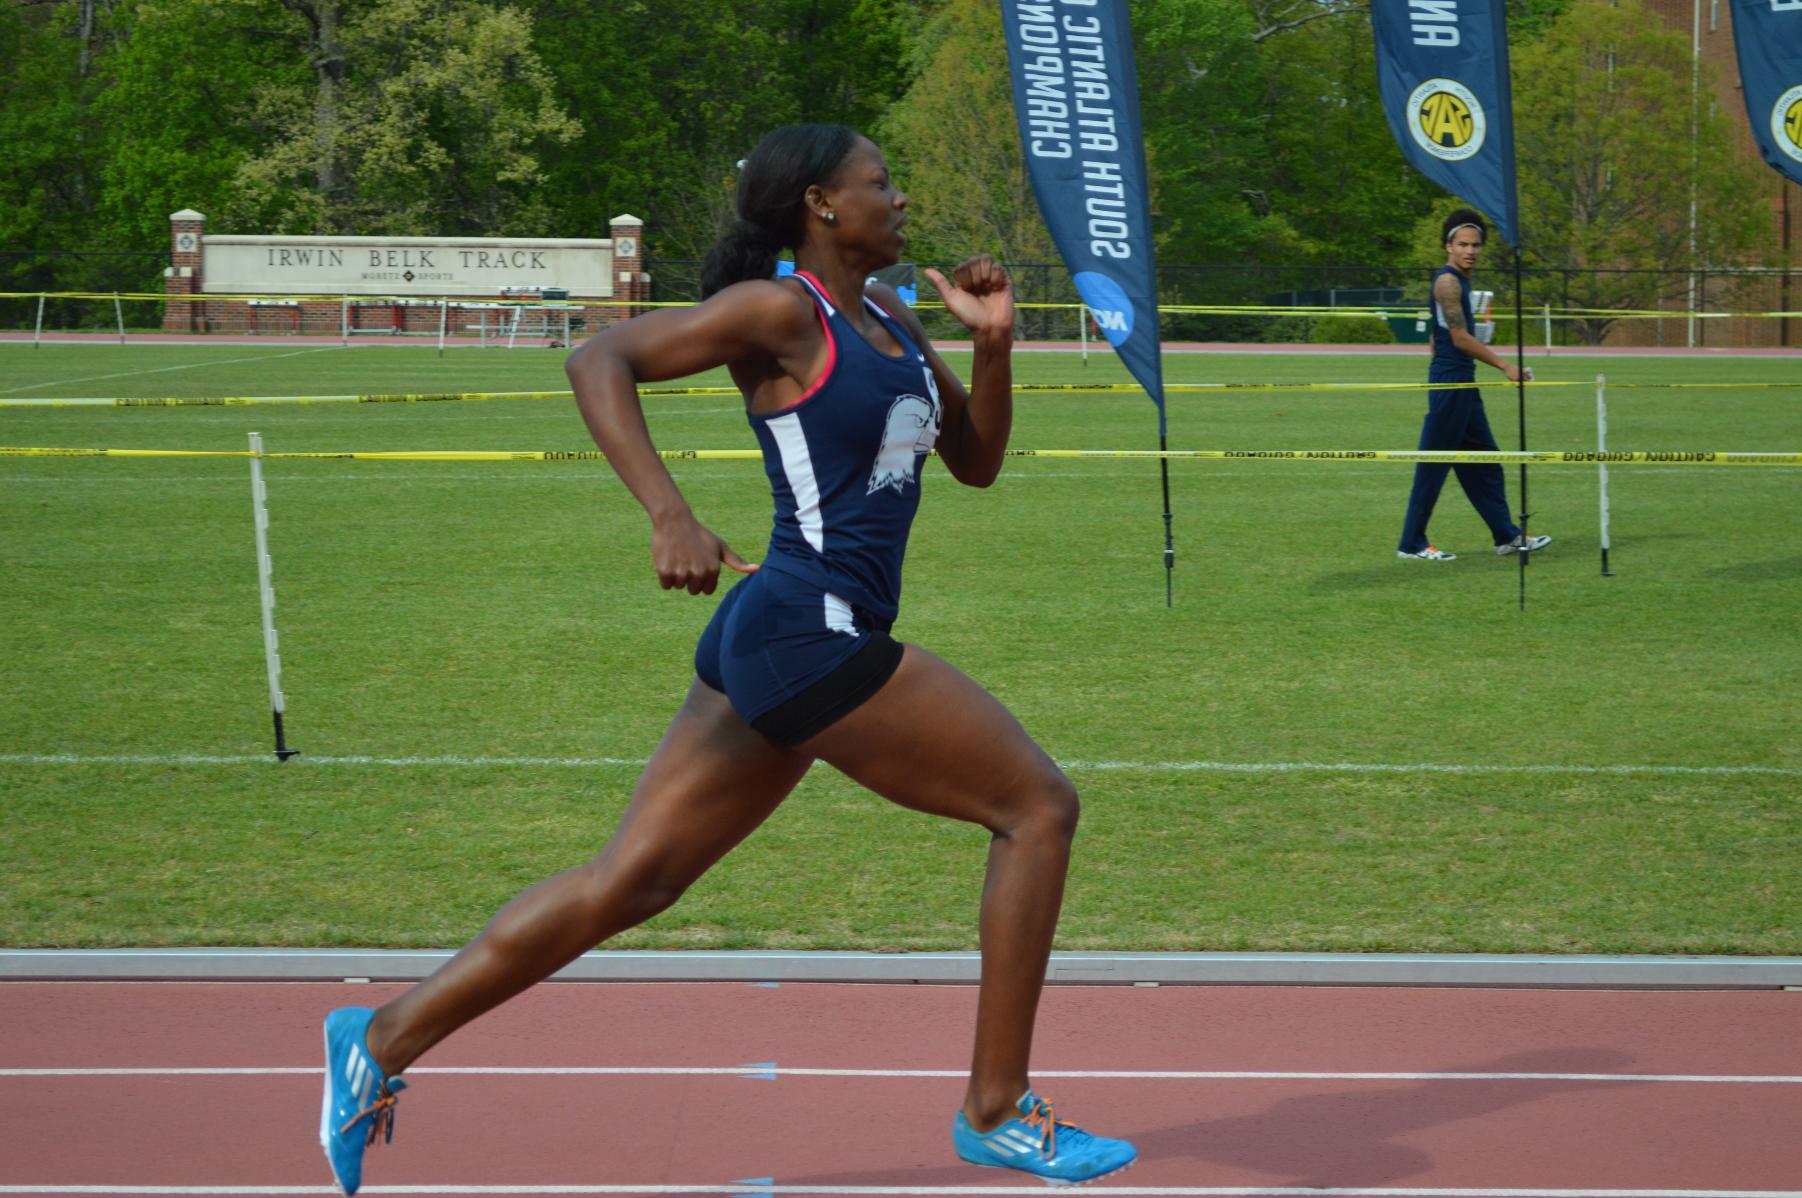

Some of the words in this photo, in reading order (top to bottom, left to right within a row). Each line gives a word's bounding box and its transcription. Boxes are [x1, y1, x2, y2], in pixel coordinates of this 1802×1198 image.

[267, 249, 344, 267] IRWIN
[369, 250, 435, 268] BELK
[458, 250, 547, 269] TRACK
